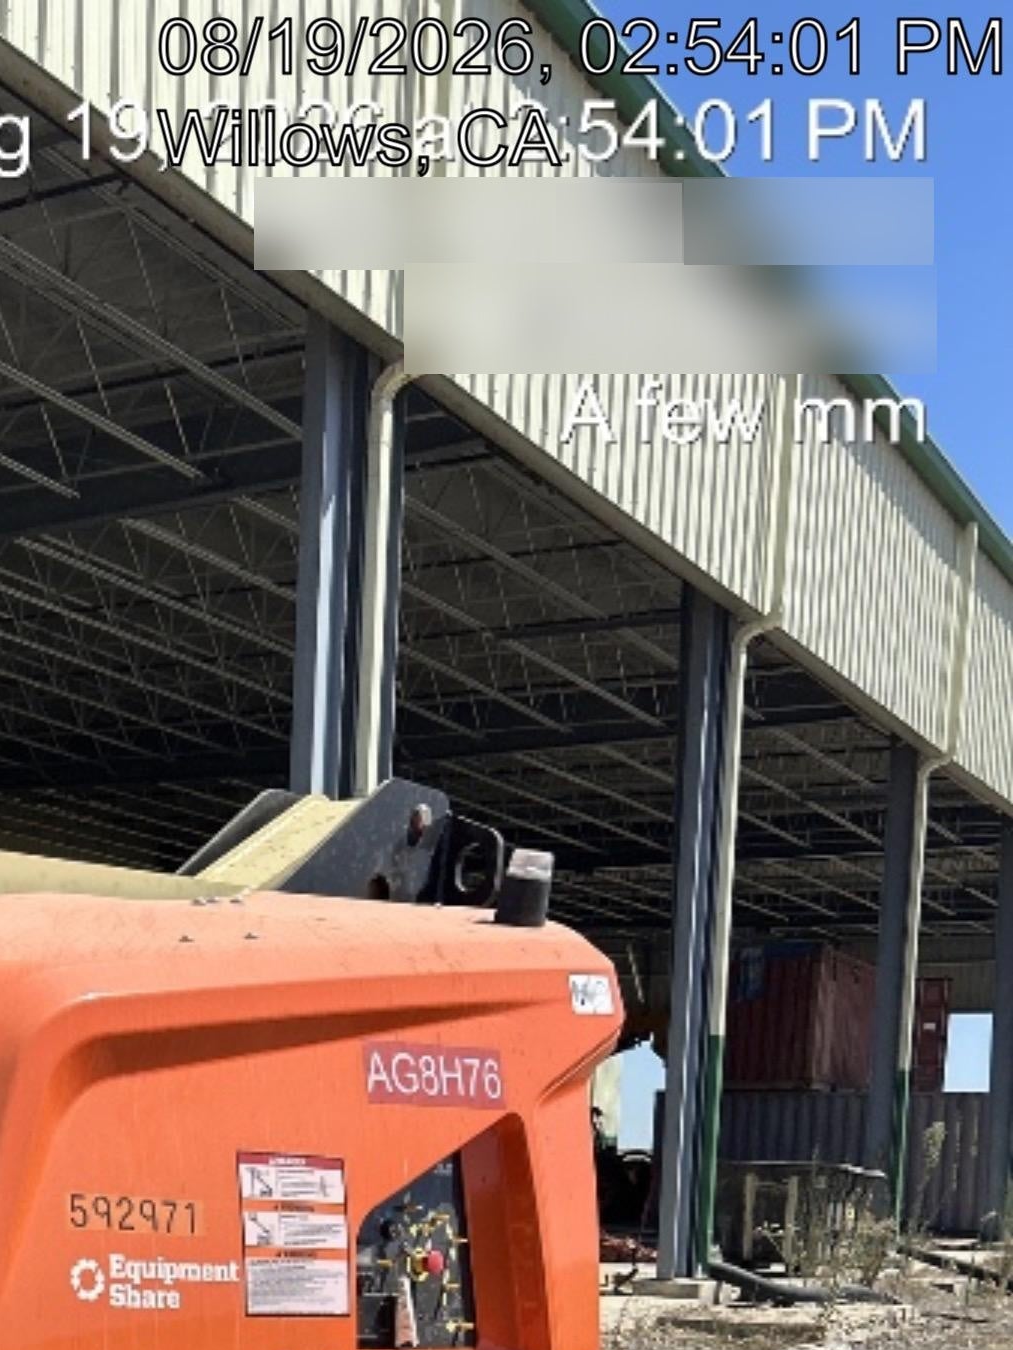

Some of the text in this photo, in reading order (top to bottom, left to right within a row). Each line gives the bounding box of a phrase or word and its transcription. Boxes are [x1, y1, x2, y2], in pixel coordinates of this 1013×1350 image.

[367, 1051, 503, 1100] AG8H76
[69, 1193, 197, 1235] 592971
[109, 1253, 240, 1285] Equipment
[109, 1283, 181, 1310] Share
